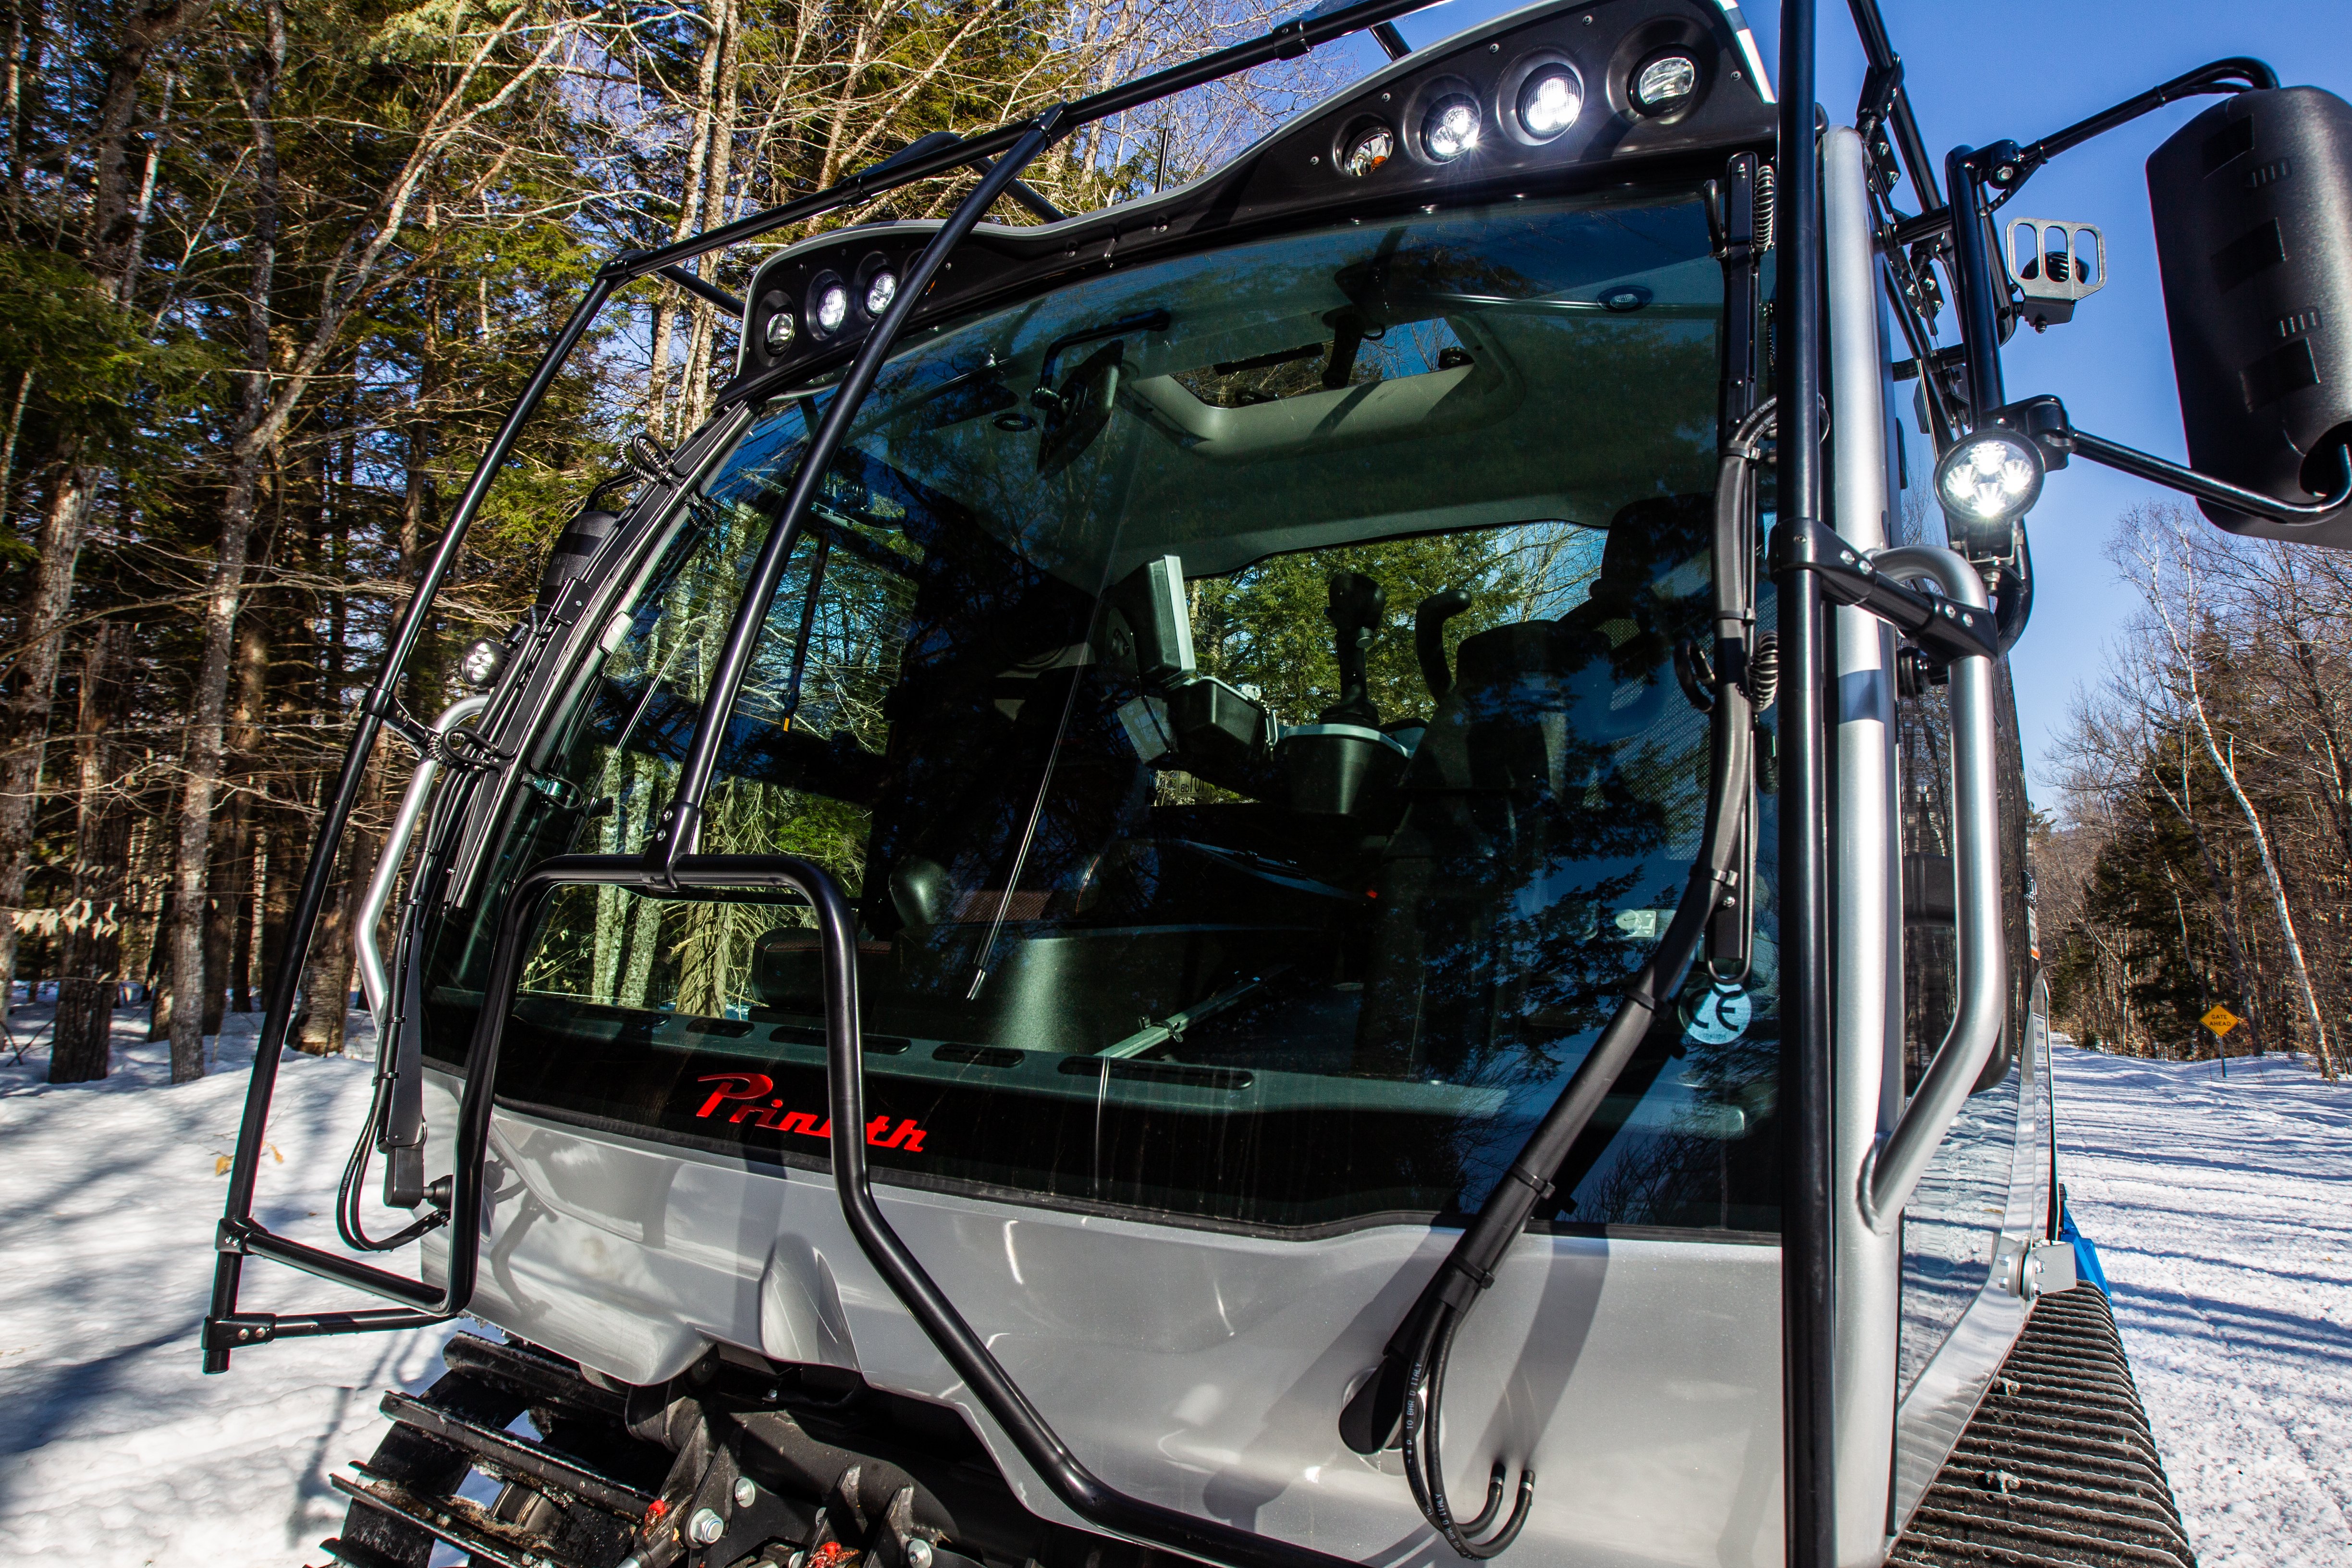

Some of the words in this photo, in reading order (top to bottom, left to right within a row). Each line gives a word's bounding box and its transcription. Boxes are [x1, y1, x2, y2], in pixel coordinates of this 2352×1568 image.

[1686, 987, 1743, 1032] CE
[696, 1072, 927, 1152] Printh
[1411, 1362, 1422, 1386] ITALY
[1407, 1400, 1415, 1416] BAR
[1407, 1420, 1414, 1429] 10
[1435, 1494, 1446, 1516] ITALY
[1445, 1527, 1456, 1540] BAR
